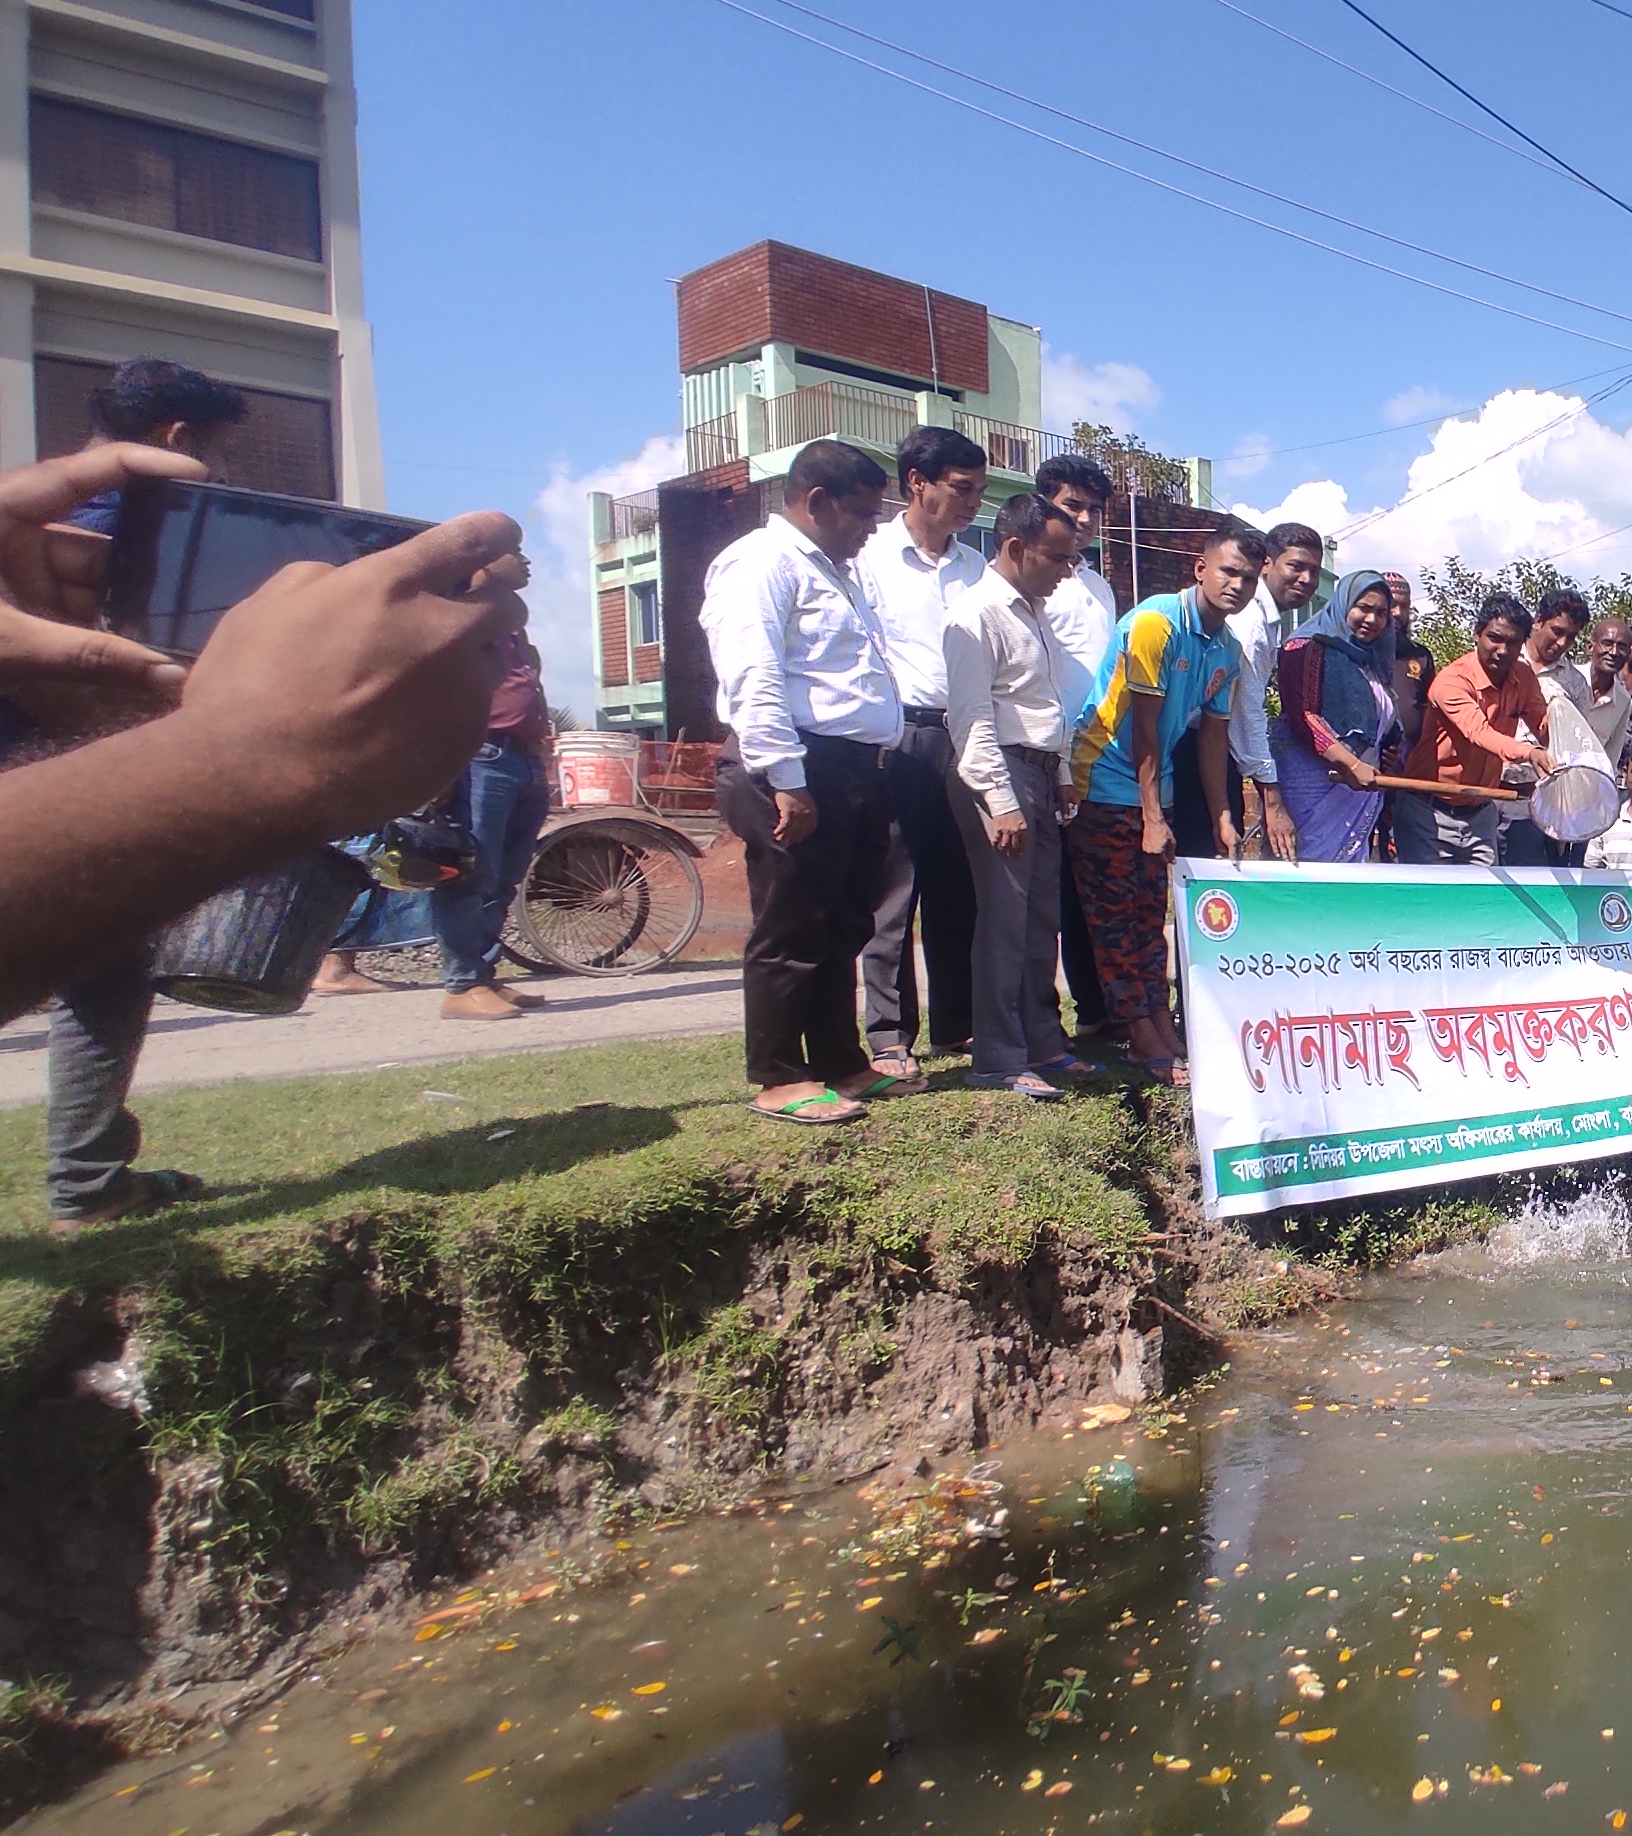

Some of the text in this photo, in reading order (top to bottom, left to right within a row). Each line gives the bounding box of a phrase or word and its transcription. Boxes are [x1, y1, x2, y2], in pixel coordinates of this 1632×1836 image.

[1218, 942, 1632, 980] ২০২৪-২০২৫ অর্থ বছরের রাজস্ব বাজেটের আওতায়
[1240, 1003, 1421, 1092] পোনামাছ
[1309, 1142, 1347, 1171] সিনিয়র
[1347, 1139, 1406, 1164] উপজেলা
[1407, 1134, 1443, 1156] মৎস্য
[1444, 1124, 1515, 1151] অফিসারের
